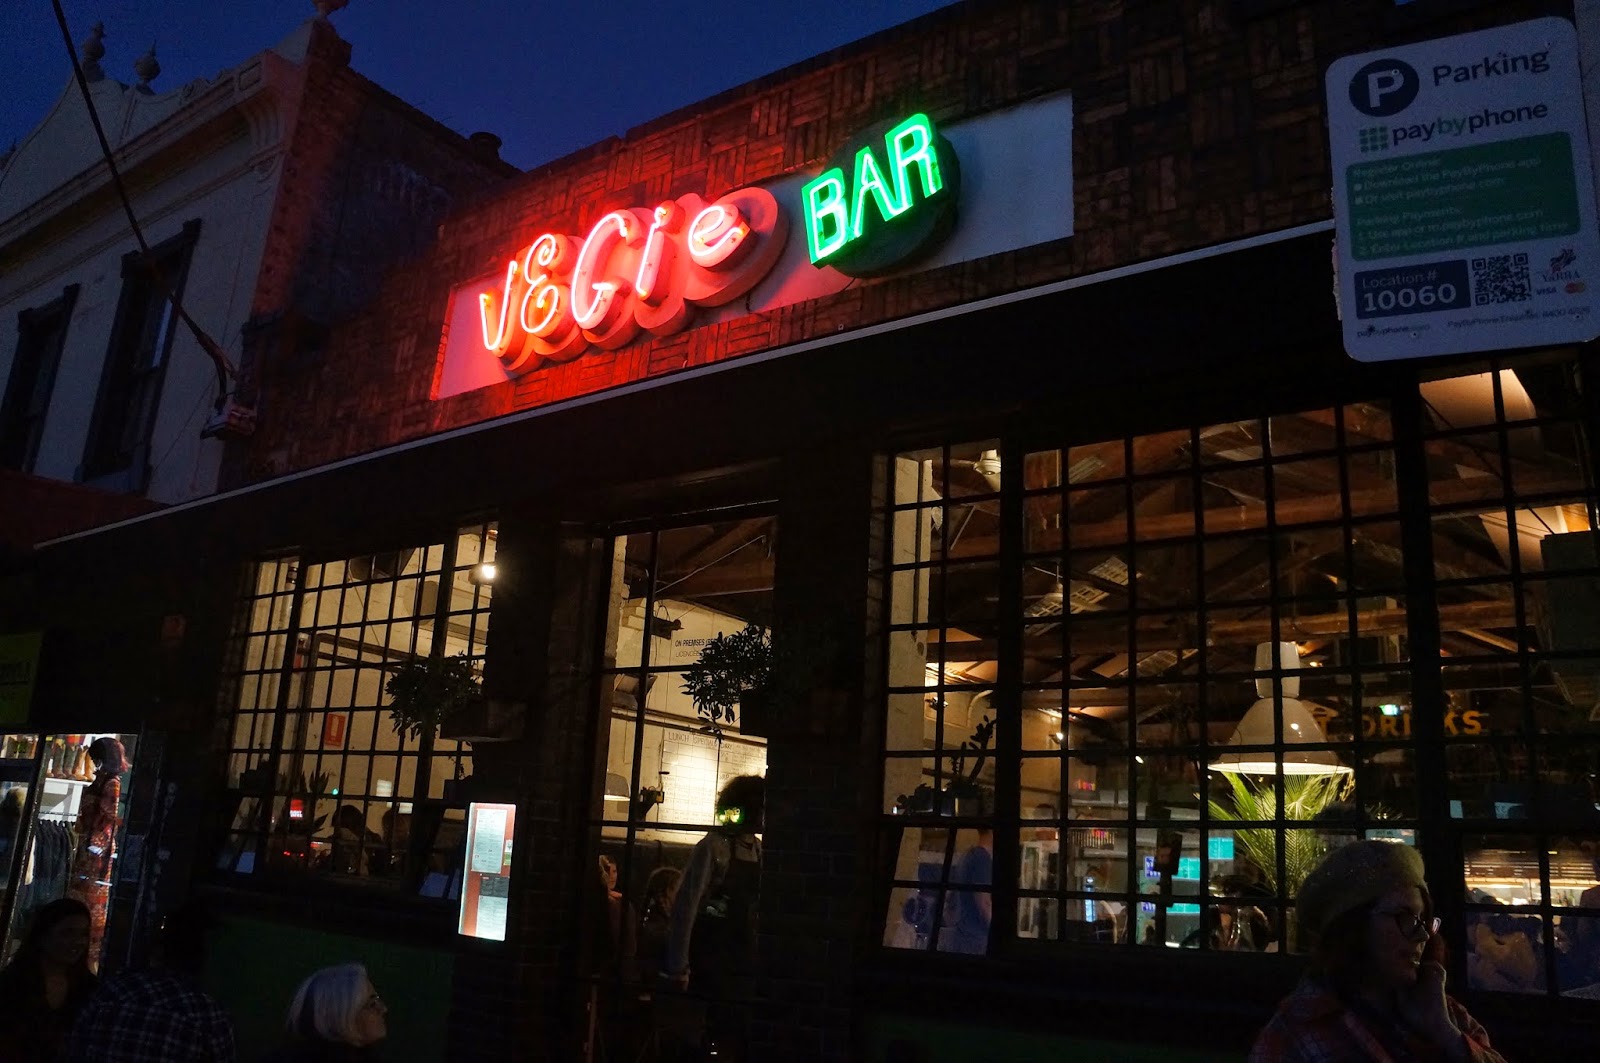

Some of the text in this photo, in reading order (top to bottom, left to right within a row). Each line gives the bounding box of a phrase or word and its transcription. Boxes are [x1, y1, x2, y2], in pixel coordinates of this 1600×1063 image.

[1432, 50, 1551, 87] Parking
[1391, 103, 1549, 146] paybyphone
[802, 113, 943, 268] BAR
[1361, 272, 1424, 289] Location
[1364, 283, 1457, 312] 10060
[668, 731, 689, 743] LUNCH
[1362, 709, 1483, 736] DRIKS
